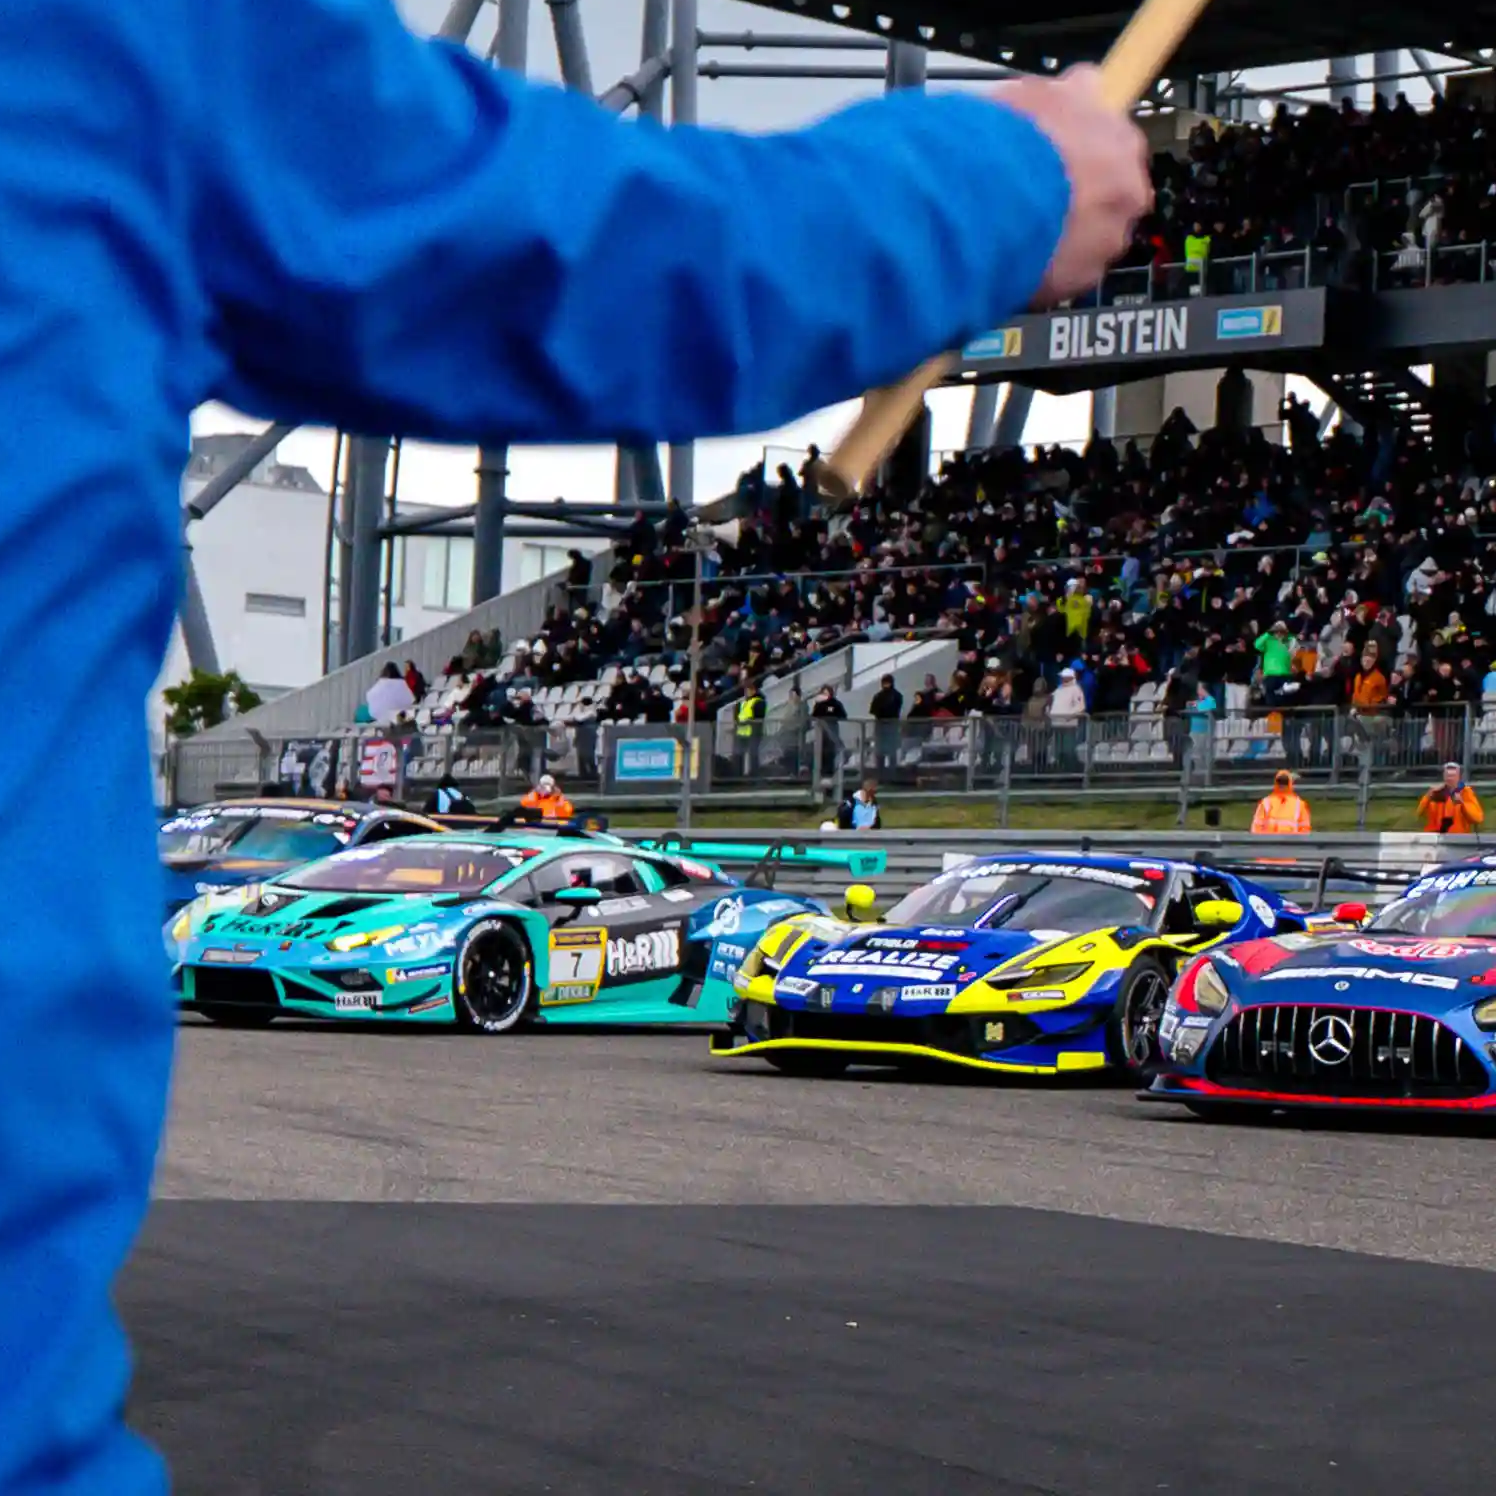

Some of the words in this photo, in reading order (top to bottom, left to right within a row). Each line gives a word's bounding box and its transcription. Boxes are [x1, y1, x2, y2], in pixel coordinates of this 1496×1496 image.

[1048, 306, 1188, 360] BILSTEIN
[1407, 870, 1478, 900] 24H
[570, 952, 583, 978] 7
[818, 950, 960, 970] REALIZE
